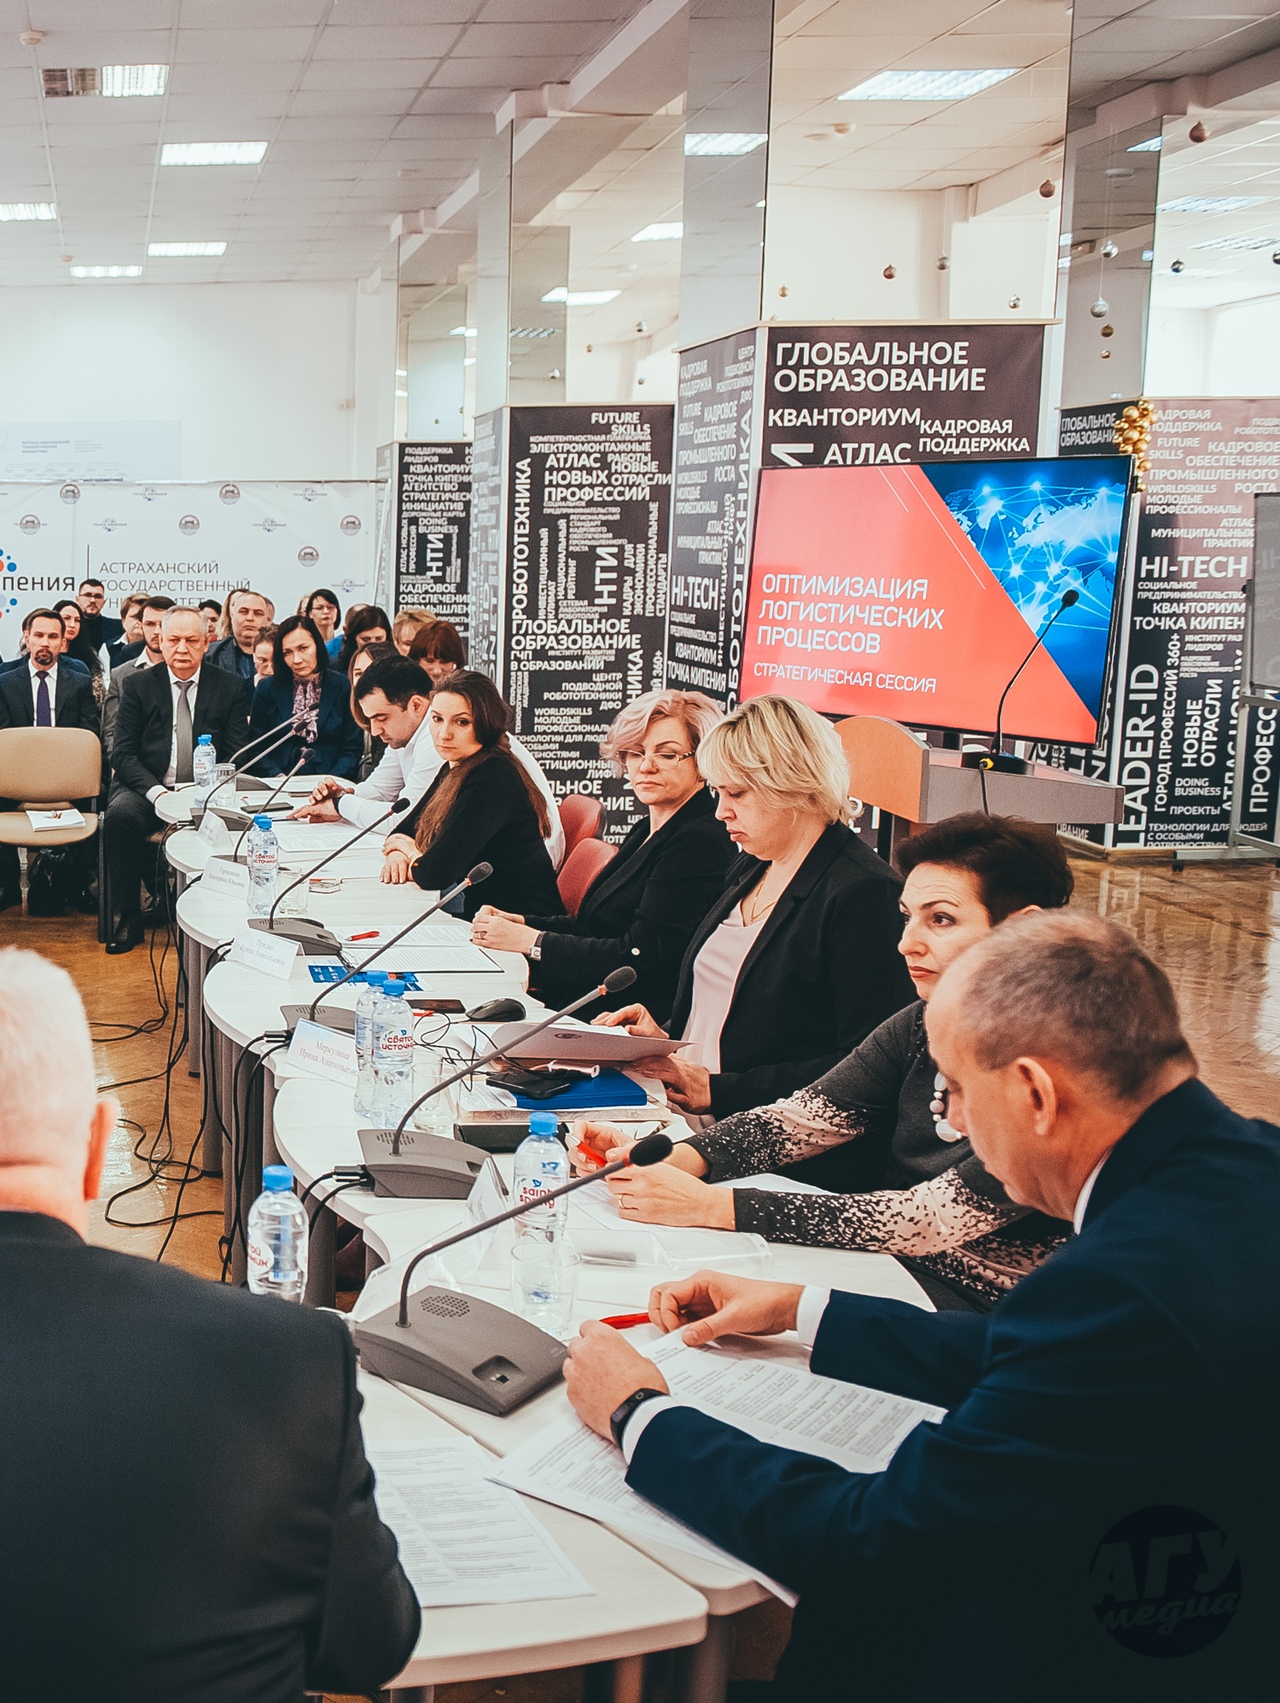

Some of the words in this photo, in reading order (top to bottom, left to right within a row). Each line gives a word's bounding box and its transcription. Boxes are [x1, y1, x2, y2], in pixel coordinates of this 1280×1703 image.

[775, 341, 969, 366] ГЛОБАЛЬНОЕ
[773, 368, 986, 392] ОБРАЗОВАНИЕ
[591, 412, 640, 424] FUTURE
[704, 400, 738, 423] КАДРОВОЕ
[768, 407, 921, 427] КВАНТОРИУМ
[1156, 409, 1211, 421] АДРОВАЯ
[920, 419, 1013, 437] КАДРОВАЯ
[1061, 412, 1117, 431] ГЛОБАЛЬНОЕ
[611, 424, 651, 435] SKILLS
[693, 422, 737, 444] ОБЕСПЕЧЕНИЕ
[918, 437, 1030, 455] ПОДДЕРЖКА
[1060, 432, 1116, 447] ОБРАЗОВАНИ
[1157, 437, 1200, 447] FUTURE
[530, 442, 651, 453] ЭЛЕКТРОМОНТАЖНЫЕ
[823, 443, 912, 465] АТЛАС
[1149, 449, 1183, 460] SKILLS
[1208, 441, 1280, 454] КАДРОВОЕ
[545, 453, 601, 468] АТЛАС
[607, 453, 651, 463] РАБОТЫ
[1185, 455, 1280, 467] ОБЕСПЕЧЕНИЕ
[611, 461, 659, 473] НОВЫЕ
[714, 465, 736, 483] РОСТА
[403, 474, 433, 482] ТОЧКА
[544, 470, 608, 485] НОВЫХ
[611, 473, 672, 486] ОТРАСЛИ
[1149, 469, 1278, 480] ПРОМЫШЛЕННОГО
[402, 482, 458, 491] АГЕНТСТВО
[544, 483, 650, 501] ПРОФЕССИЙ
[1147, 484, 1217, 494] WORLDSKILLS
[1234, 482, 1277, 494] РОСТА
[402, 502, 464, 511] ИНИЦИАТИВ
[1146, 495, 1203, 505] МОЛОДЫЕ
[1145, 505, 1242, 515] ПРОФЕССИОНАЛЫ
[419, 525, 459, 533] BUSINESS
[1220, 518, 1255, 528] АТЛАС
[512, 457, 531, 619] РОБОТОТЕХНИКА
[1151, 528, 1255, 539] МУНИЦИПАЛЬНЫХ
[1203, 538, 1255, 548] ПРАКТИК
[426, 533, 444, 576] НТИ
[557, 519, 567, 599] НАЦИОНАЛЬНЫЙ
[624, 543, 635, 568] ДЛЯ
[645, 502, 659, 617] ПРОФЕССИОНАЛЬНЫЕ
[99, 560, 219, 574] АСТРАХАНСКИЙ
[727, 408, 752, 716] ОБОТОТЕХНИКА
[1140, 555, 1248, 578] HI-TECH
[538, 527, 549, 619] ИНВЕСТИЦИОННЫЙ
[567, 558, 576, 599] РЕЙТИНГ
[594, 546, 618, 604] НТИ
[634, 543, 645, 616] ЭКОНОМИКИ
[400, 584, 457, 594] КАДРОВОЕ
[656, 553, 667, 617] СТАНДАРТЫ
[762, 574, 928, 602] ОПТИМИЗАЦИЯ
[1138, 581, 1198, 590] СОЦИАЛЬНОЕ
[547, 580, 556, 619] КЛИМАТ
[623, 576, 634, 616] КАДРЫ
[671, 575, 719, 611] HI-TECH
[1137, 591, 1246, 600] ПРЕДПРИНИМАТЕЛЬСТВО
[758, 600, 945, 630] ЛОГИСТИЧЕСКИХ
[1152, 602, 1246, 614] КВАНТОРИУМ
[512, 618, 631, 634] ГЛОБАЛЬНОЕ
[1133, 616, 1187, 630] ТОЧКА
[1190, 616, 1245, 630] КИПЕН
[511, 634, 641, 650] ОБРАЗОВАНИЕ
[757, 625, 881, 654] ПРОЦЕССОВ
[1185, 634, 1226, 642] ИНСТИТУТ
[675, 642, 717, 665] КВАНТОРИУМ
[1167, 632, 1181, 667] 360+
[1184, 643, 1223, 652] ЛИДЕРОВ
[511, 650, 532, 660] ГЧП
[510, 661, 518, 671] В
[592, 673, 622, 682] ЦЕНТР
[667, 661, 690, 683] ТОЧКА
[690, 668, 726, 693] КИПЕНИЯ
[754, 662, 873, 687] СТРАТЕГИЧЕСКАЯ
[875, 674, 937, 693] СЕССИЯ
[562, 681, 622, 691] ПОДВОДНОЙ
[544, 692, 622, 701] РОБОТОТЕХНИКИ
[534, 708, 592, 716] WORLDSKILLS
[600, 701, 622, 710] ДФО
[1158, 669, 1179, 759] ПРОФЕССИЙ
[1200, 678, 1223, 768] ОТРАСЛИ
[1182, 699, 1203, 768] НОВЫЕ
[1117, 664, 1160, 848] LEADER-ID
[1154, 762, 1173, 812] ГОРОД
[1175, 777, 1209, 787] DOING
[1174, 787, 1221, 796] BUSINESS
[1170, 806, 1220, 816] ПРОЕКТЫ
[1149, 823, 1210, 832] ТЕХНОЛОГИИ
[1147, 832, 1154, 840] С
[1155, 832, 1204, 840] ОСОБЫМИ
[387, 1035, 413, 1044] свято
